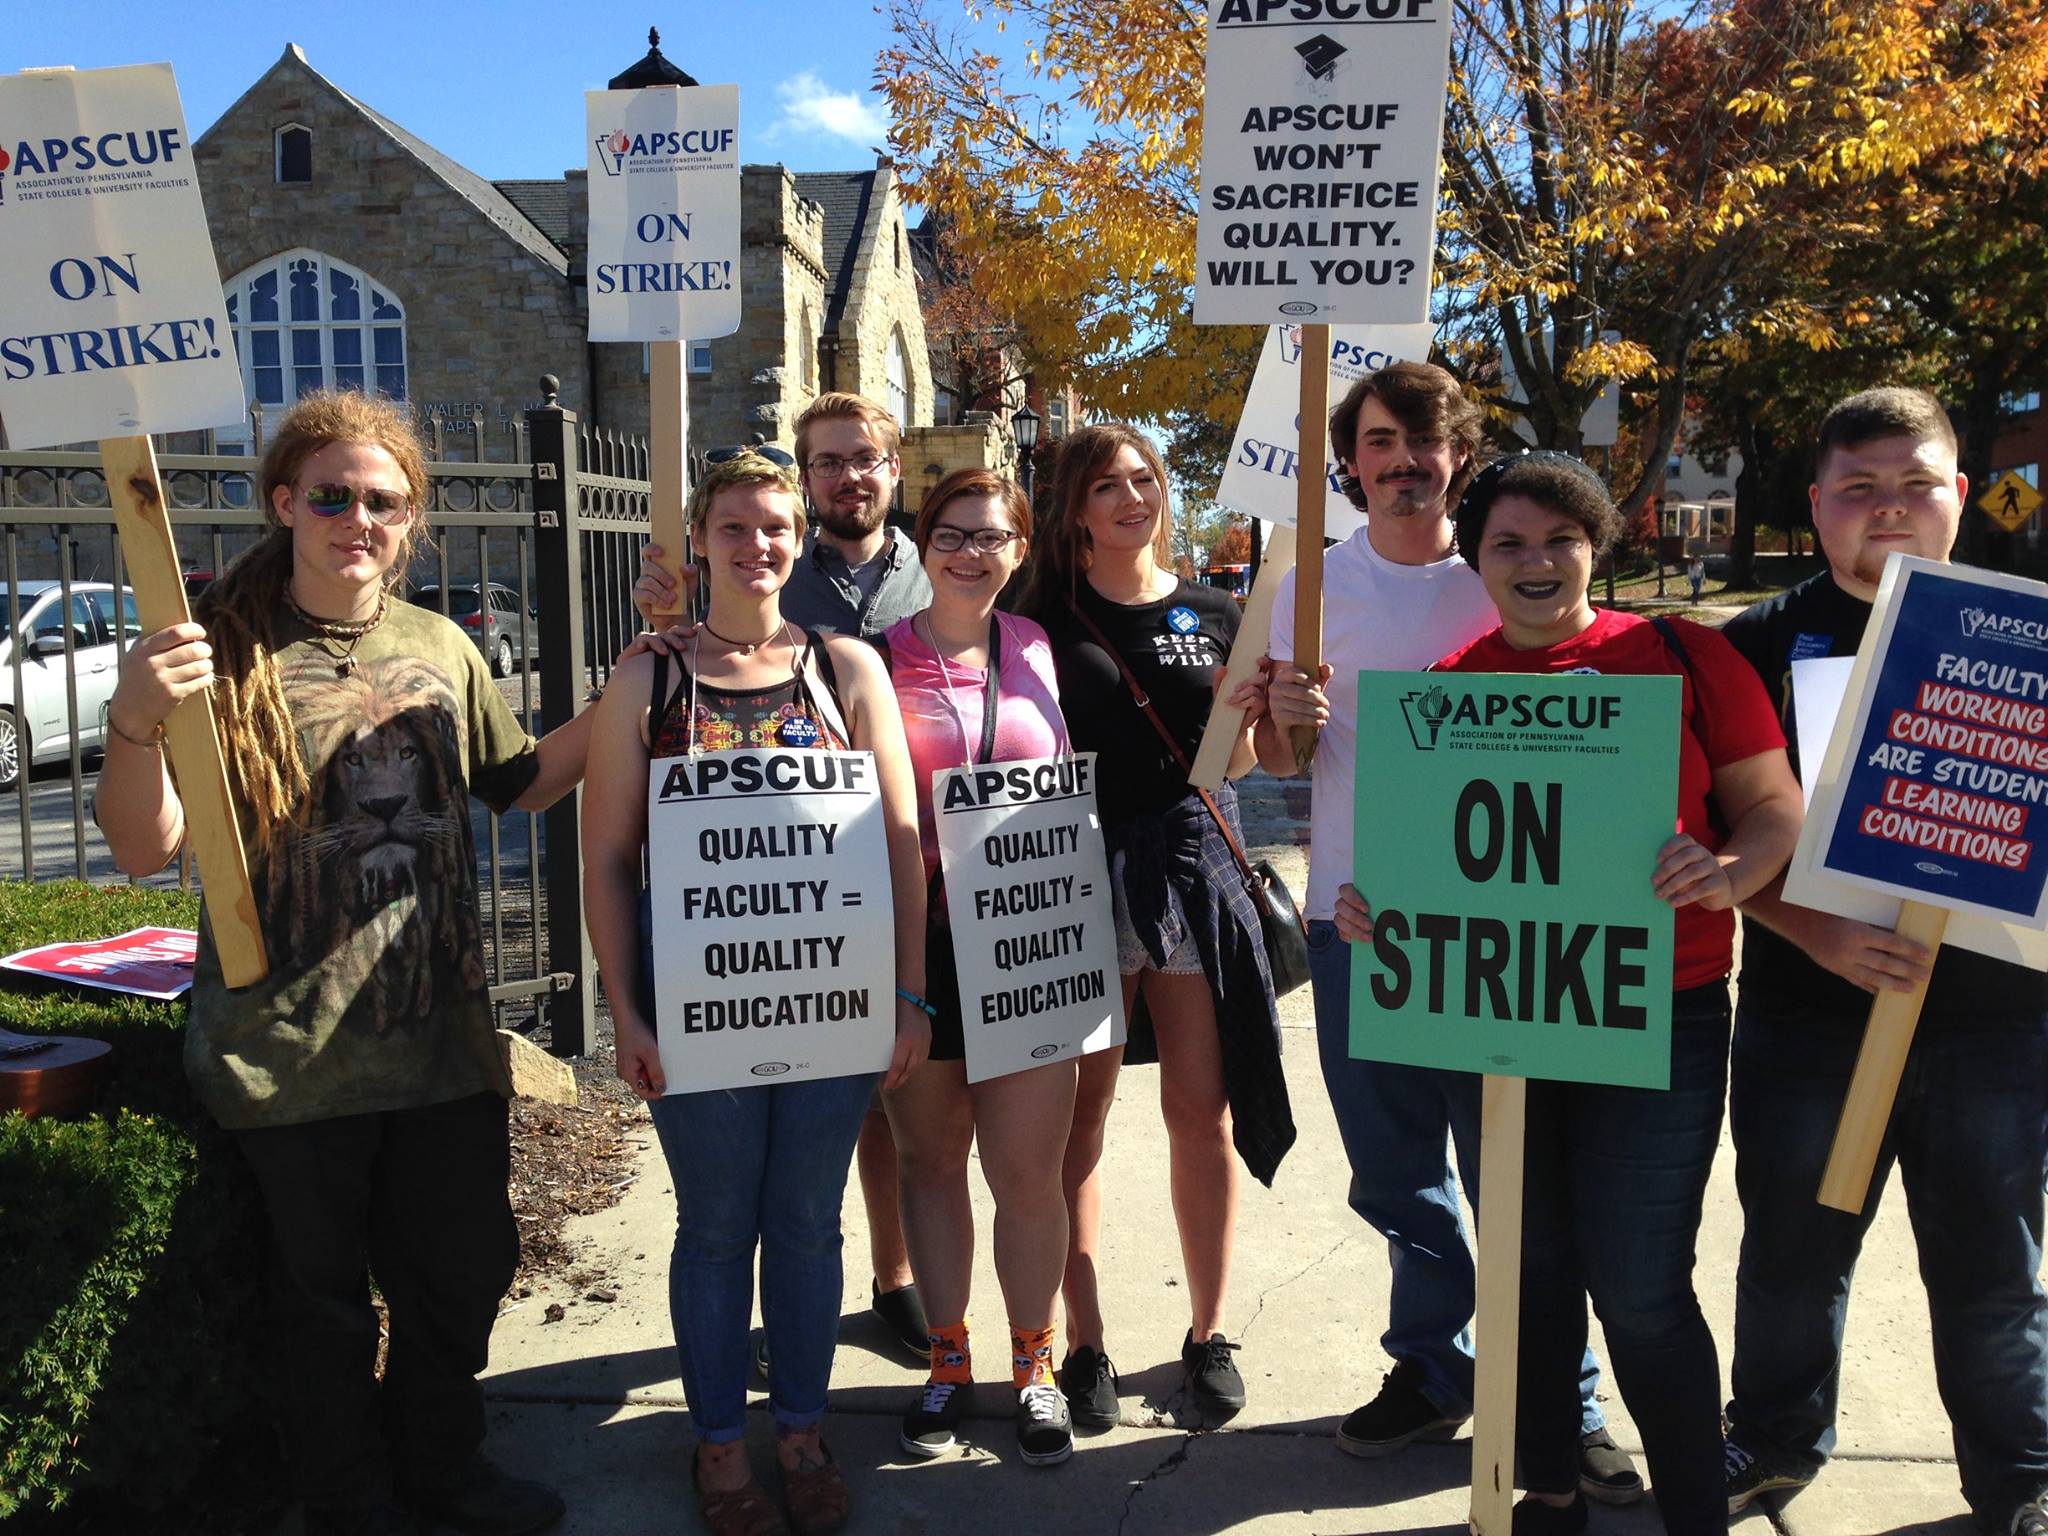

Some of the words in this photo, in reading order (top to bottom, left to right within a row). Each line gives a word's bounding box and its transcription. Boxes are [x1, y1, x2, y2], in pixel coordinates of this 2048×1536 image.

[1240, 104, 1399, 133] APSCUF
[13, 128, 181, 176] APSCUF
[629, 129, 734, 156] APSCUF
[1253, 144, 1381, 171] WON'T
[16, 176, 74, 190] ASSOCIATION
[75, 175, 86, 184] OF
[88, 170, 153, 183] PENNSYLVANIA
[18, 191, 45, 201] STATE
[46, 189, 83, 198] COLLEGE
[84, 187, 91, 195] &
[94, 183, 144, 195] UNIVERSITY
[145, 178, 189, 190] FACULTIES
[1212, 182, 1419, 210] SACRIFICE
[636, 212, 692, 243] ON
[1223, 221, 1400, 250] QUALITY.
[50, 252, 140, 301] ON
[596, 260, 732, 294] STRIKE!
[1207, 260, 1297, 286] WILL
[1310, 259, 1415, 286] YOU?
[1, 317, 221, 380] STRIKE!
[1331, 340, 1392, 371] PSC
[424, 403, 484, 418] WALTER
[1152, 634, 1210, 646] KEEP
[1159, 654, 1213, 666] WILD
[1174, 644, 1197, 653] IT
[1936, 653, 2048, 700] FACULTY
[1451, 694, 1621, 729] APSCUF
[1921, 684, 2045, 735] WORKING
[1449, 742, 1473, 750] STATE
[1476, 743, 1511, 751] COLLEGE
[1522, 744, 1572, 753] UNIVERSITY
[1575, 745, 1620, 754] FACULTIES
[1450, 730, 1504, 740] ASSOCIATION
[1507, 732, 1517, 740] OF
[1520, 733, 1584, 741] PENNSYLVANIA
[1893, 712, 2048, 771] CONDITIONS
[659, 752, 865, 799] APSCUF
[1869, 742, 1925, 775] ARE
[944, 759, 1088, 809] APSCUF
[1886, 780, 2022, 833] LEARNING
[699, 823, 837, 865] QUALITY
[984, 823, 1079, 868] QUALITY
[1454, 779, 1562, 885] ON
[1864, 809, 2028, 868] CONDITIONS
[683, 880, 828, 920] FACULTY
[842, 892, 862, 906] =
[974, 875, 1074, 920] FACULTY
[1081, 883, 1092, 897] =
[704, 936, 845, 979] QUALITY
[994, 923, 1084, 972] QUALITY
[1370, 909, 1648, 1031] STRIKE
[683, 989, 869, 1034] EDUCATION
[980, 969, 1104, 1025] EDUCATION
